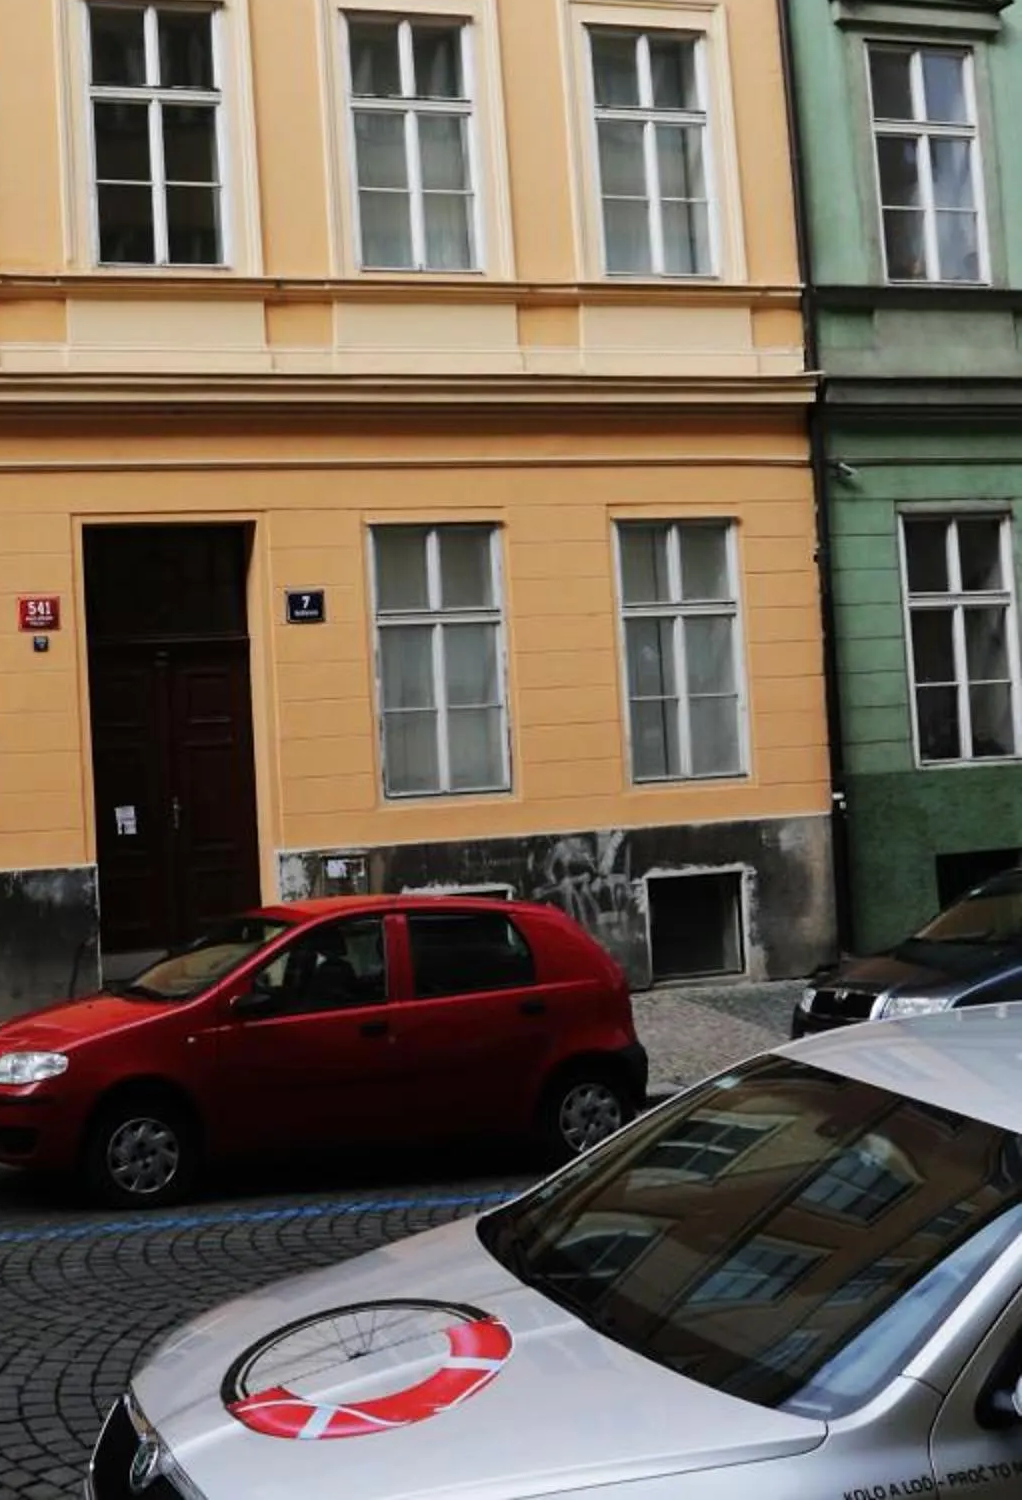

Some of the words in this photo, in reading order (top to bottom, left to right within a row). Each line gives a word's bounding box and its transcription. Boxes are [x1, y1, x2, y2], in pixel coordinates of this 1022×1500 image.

[27, 601, 51, 615] 541
[301, 595, 311, 609] 7
[889, 1483, 902, 1497] A
[987, 1461, 1012, 1478] TO
